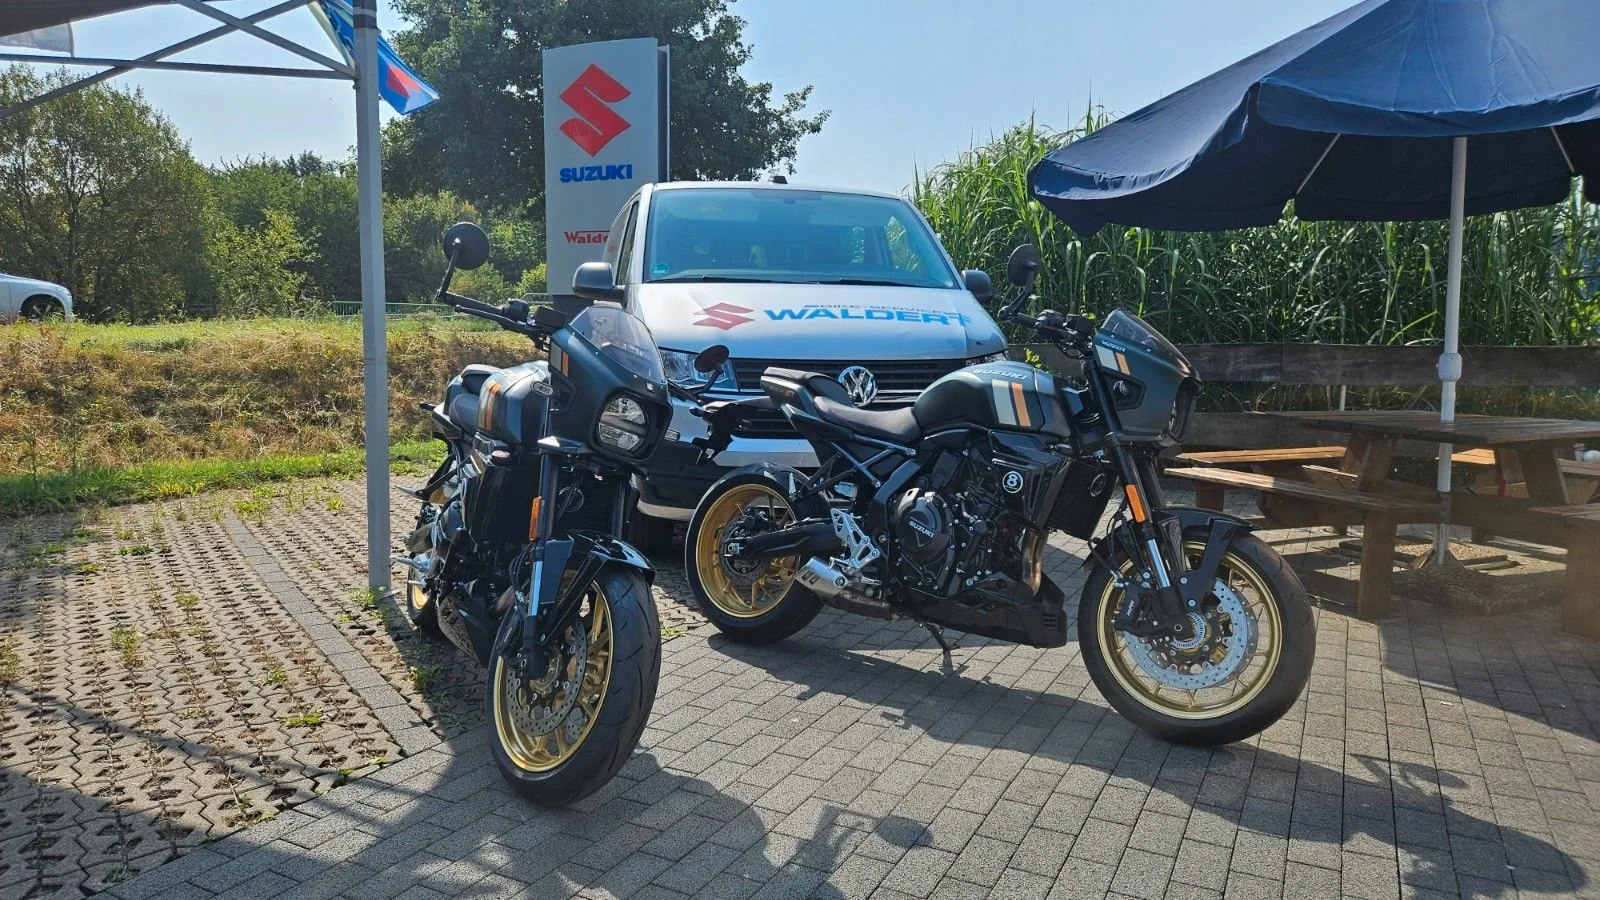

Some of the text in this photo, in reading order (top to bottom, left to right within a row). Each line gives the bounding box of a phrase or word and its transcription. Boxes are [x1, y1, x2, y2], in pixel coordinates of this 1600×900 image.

[560, 164, 632, 183] SUZUKI
[763, 308, 972, 327] WALDERT
[972, 369, 1028, 380] SUZUKI
[1006, 474, 1018, 487] 8
[909, 520, 935, 538] SUZUKI
